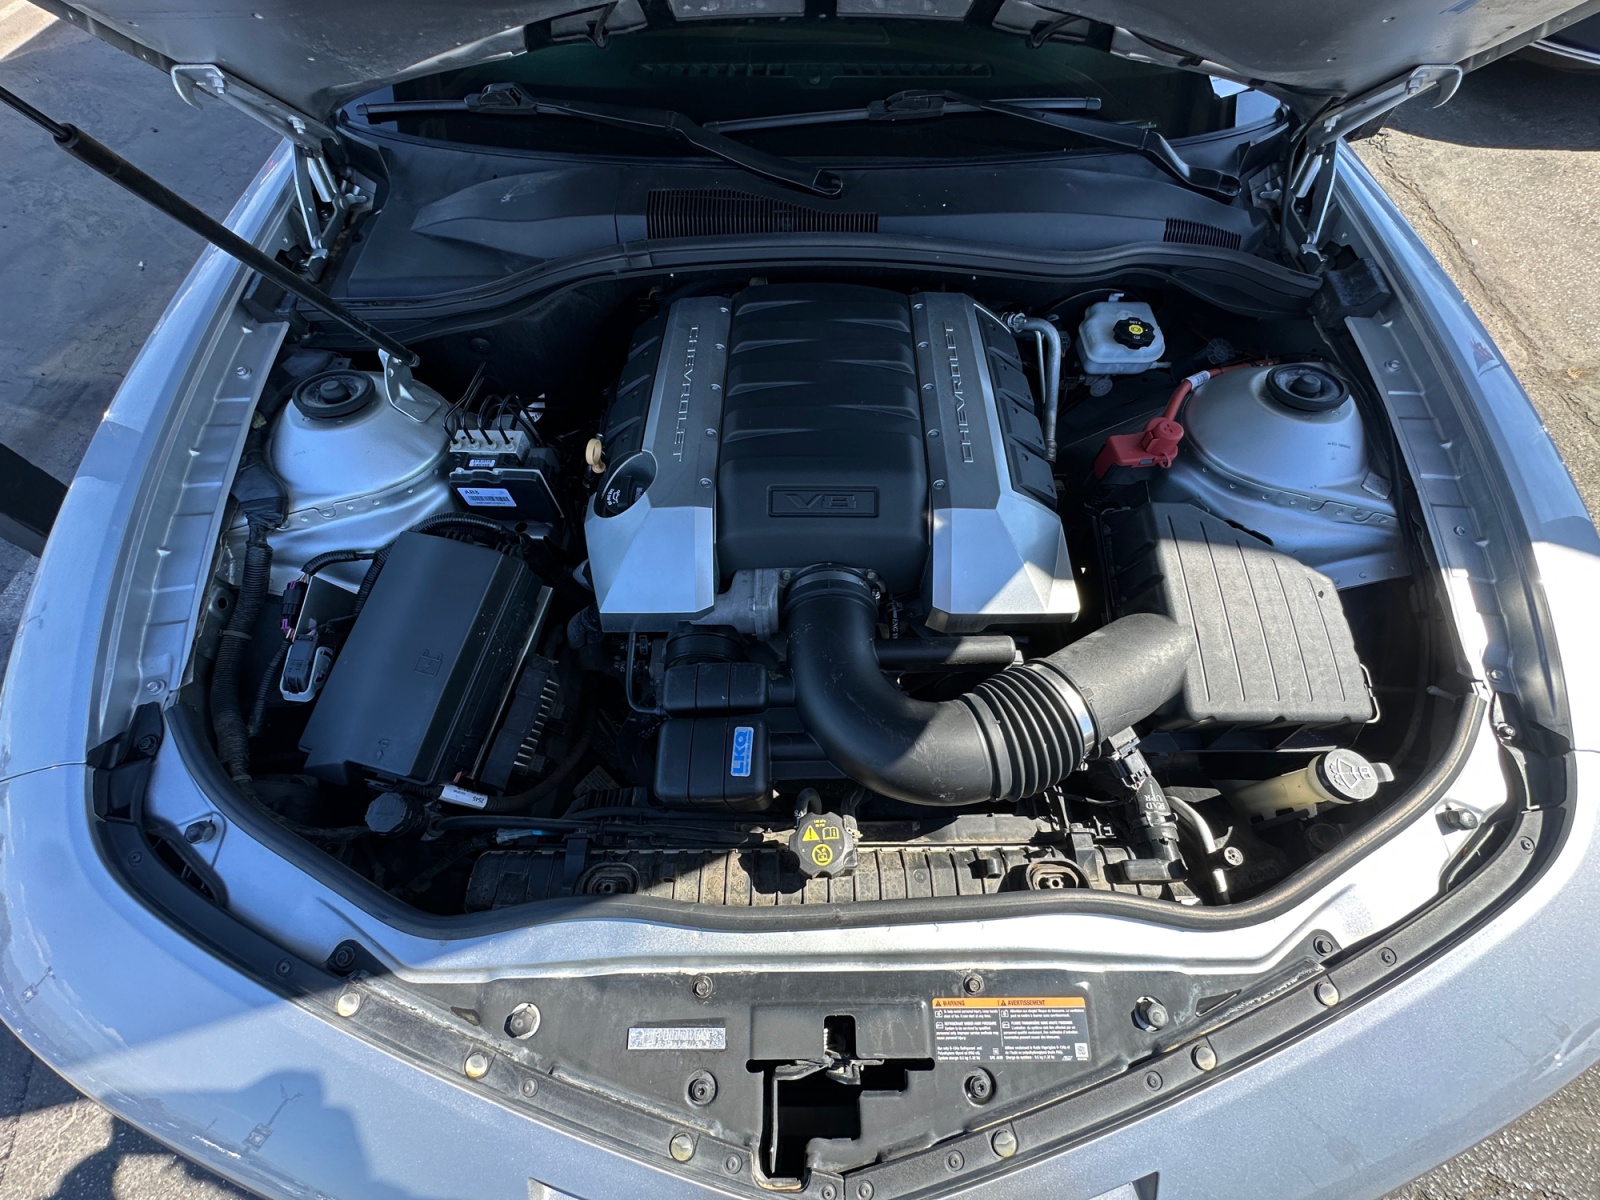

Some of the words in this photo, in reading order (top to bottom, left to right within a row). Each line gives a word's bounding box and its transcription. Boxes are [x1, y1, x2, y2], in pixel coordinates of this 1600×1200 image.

[673, 325, 699, 462] CHEVROLET
[943, 322, 973, 463] CHEVROLET
[784, 493, 857, 510] V8
[732, 731, 748, 774] LKQ
